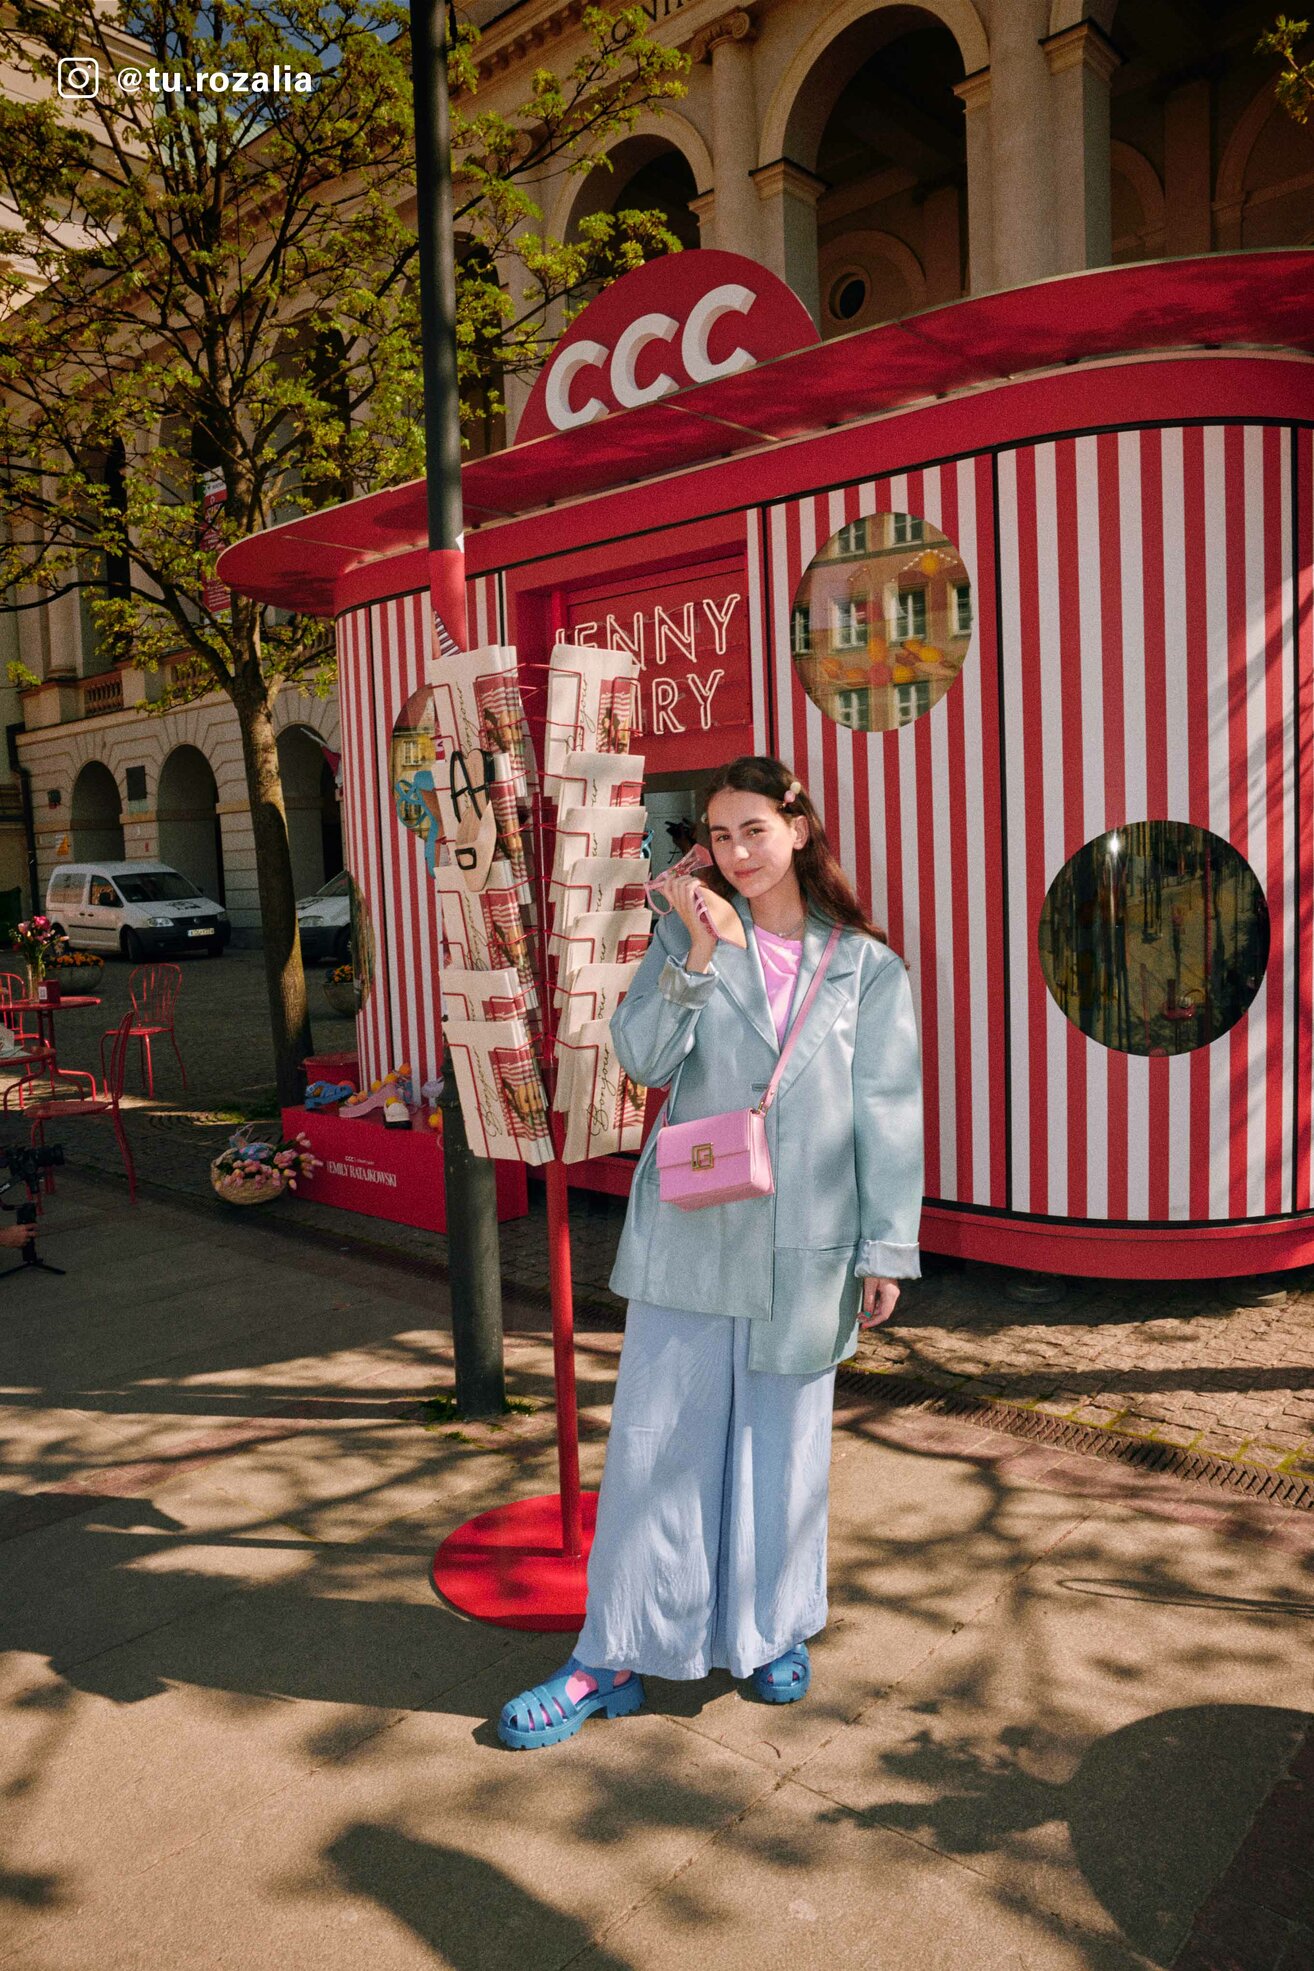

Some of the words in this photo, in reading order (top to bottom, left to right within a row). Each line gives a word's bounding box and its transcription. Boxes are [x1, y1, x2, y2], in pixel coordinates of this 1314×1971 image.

[545, 283, 757, 431] CCC
[555, 593, 741, 670] ENNY
[631, 669, 725, 738] IRY
[586, 1043, 617, 1137] Bonjour
